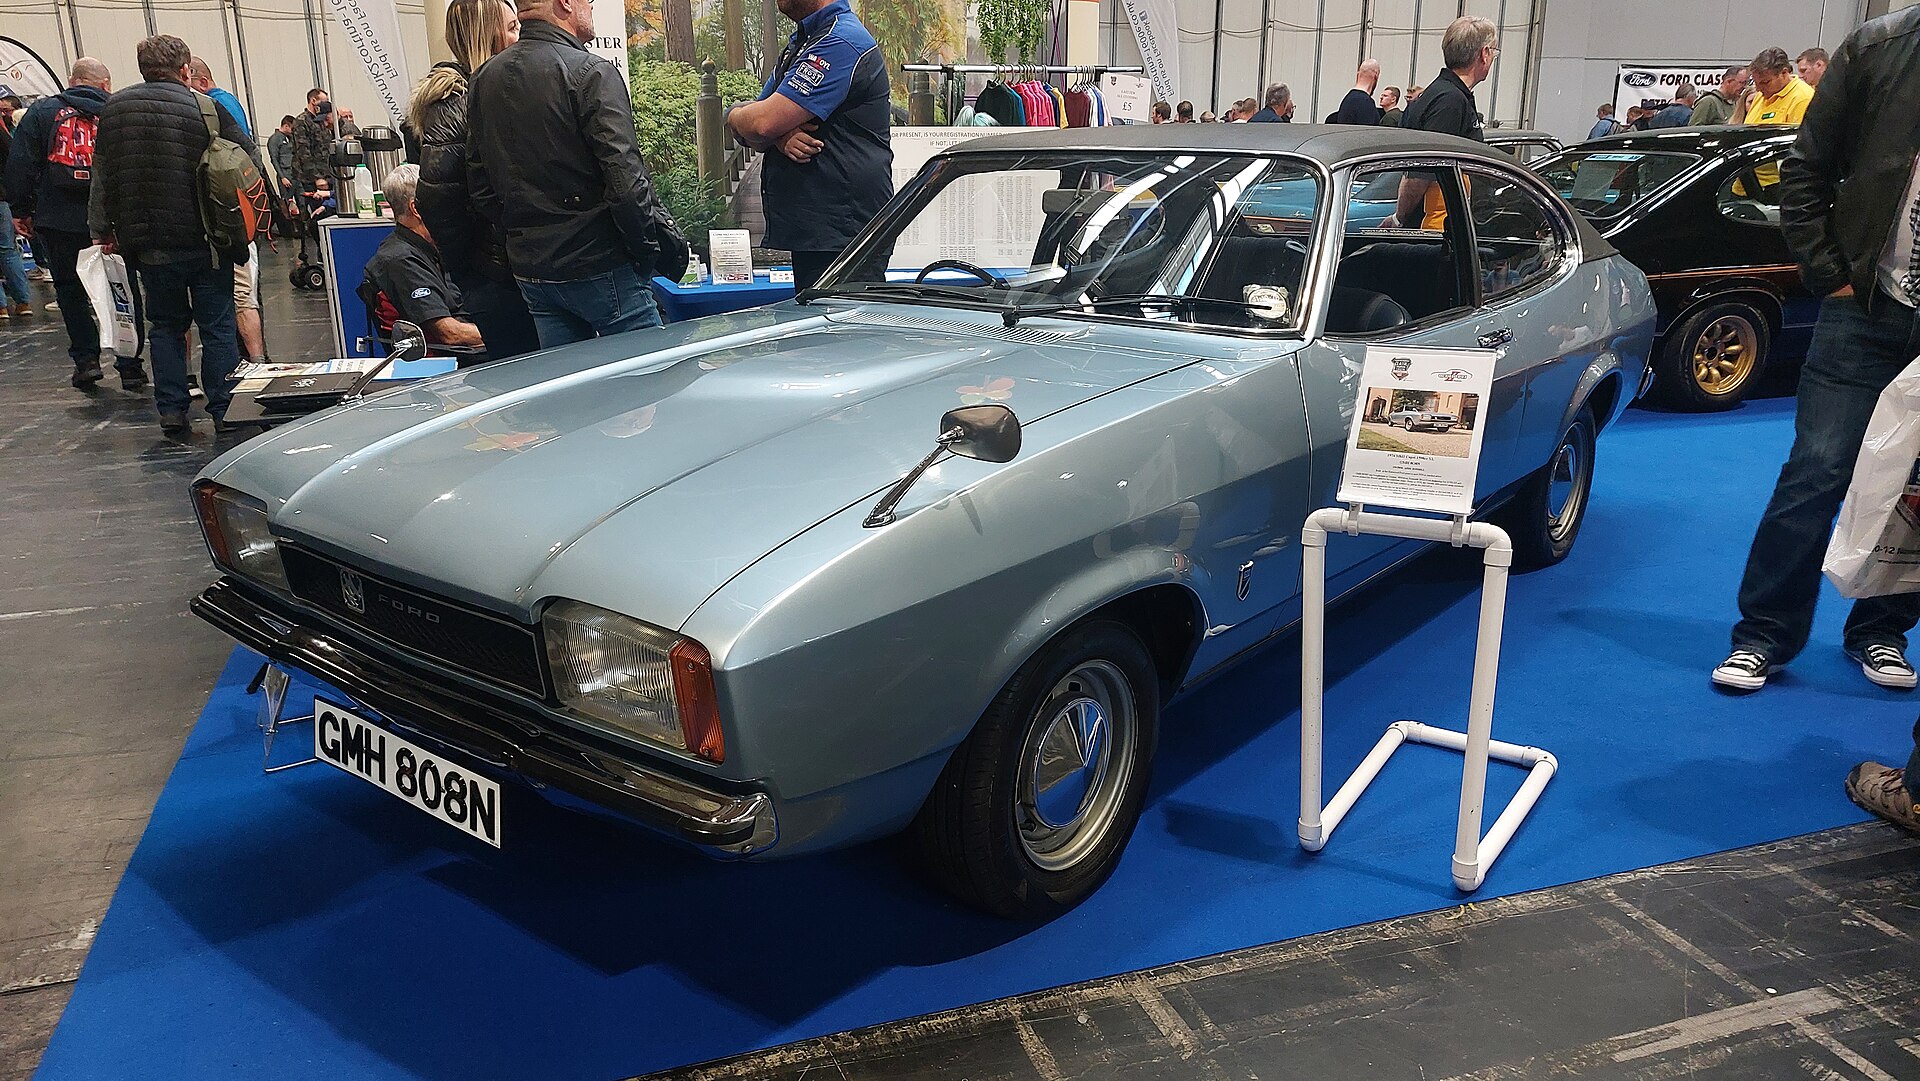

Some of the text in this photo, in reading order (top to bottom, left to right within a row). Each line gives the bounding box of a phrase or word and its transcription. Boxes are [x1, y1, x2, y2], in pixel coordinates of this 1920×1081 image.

[798, 63, 822, 83] FROST
[1629, 72, 1652, 86] Ford
[1660, 73, 1723, 86] FORD CLAS
[1122, 101, 1132, 111] £5
[378, 594, 440, 624] FORD
[318, 710, 496, 841] GMH 808N
